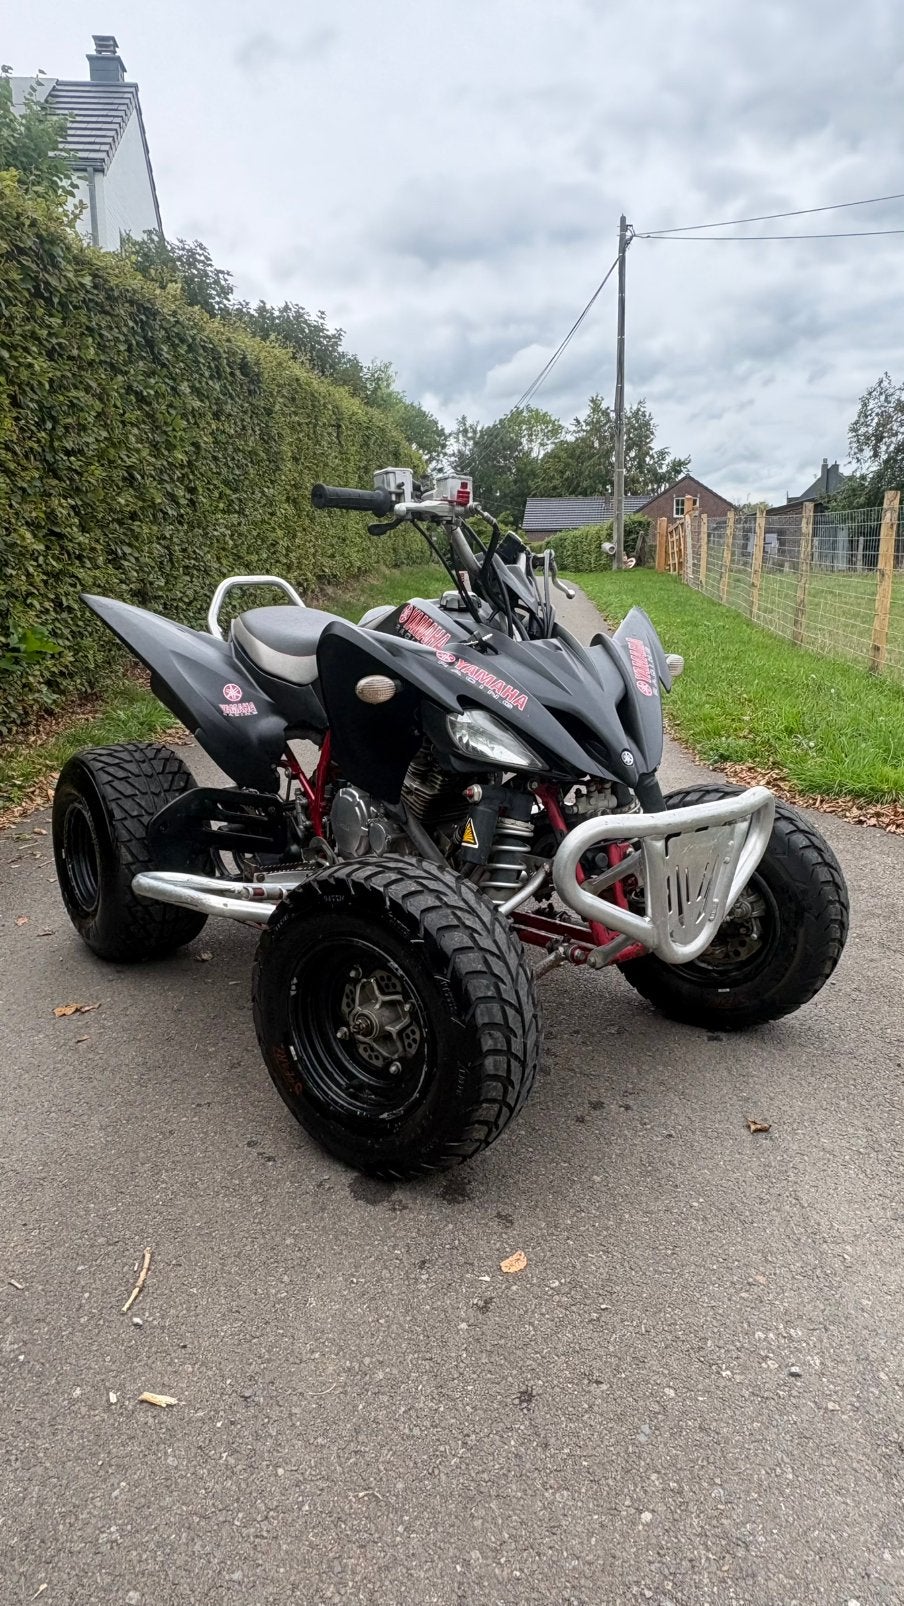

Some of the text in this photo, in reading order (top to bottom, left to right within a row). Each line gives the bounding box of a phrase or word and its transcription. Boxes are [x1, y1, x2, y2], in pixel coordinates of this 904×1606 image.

[403, 607, 451, 649] YAMAHA
[437, 661, 513, 709] RACING
[455, 659, 528, 711] YAMAHA
